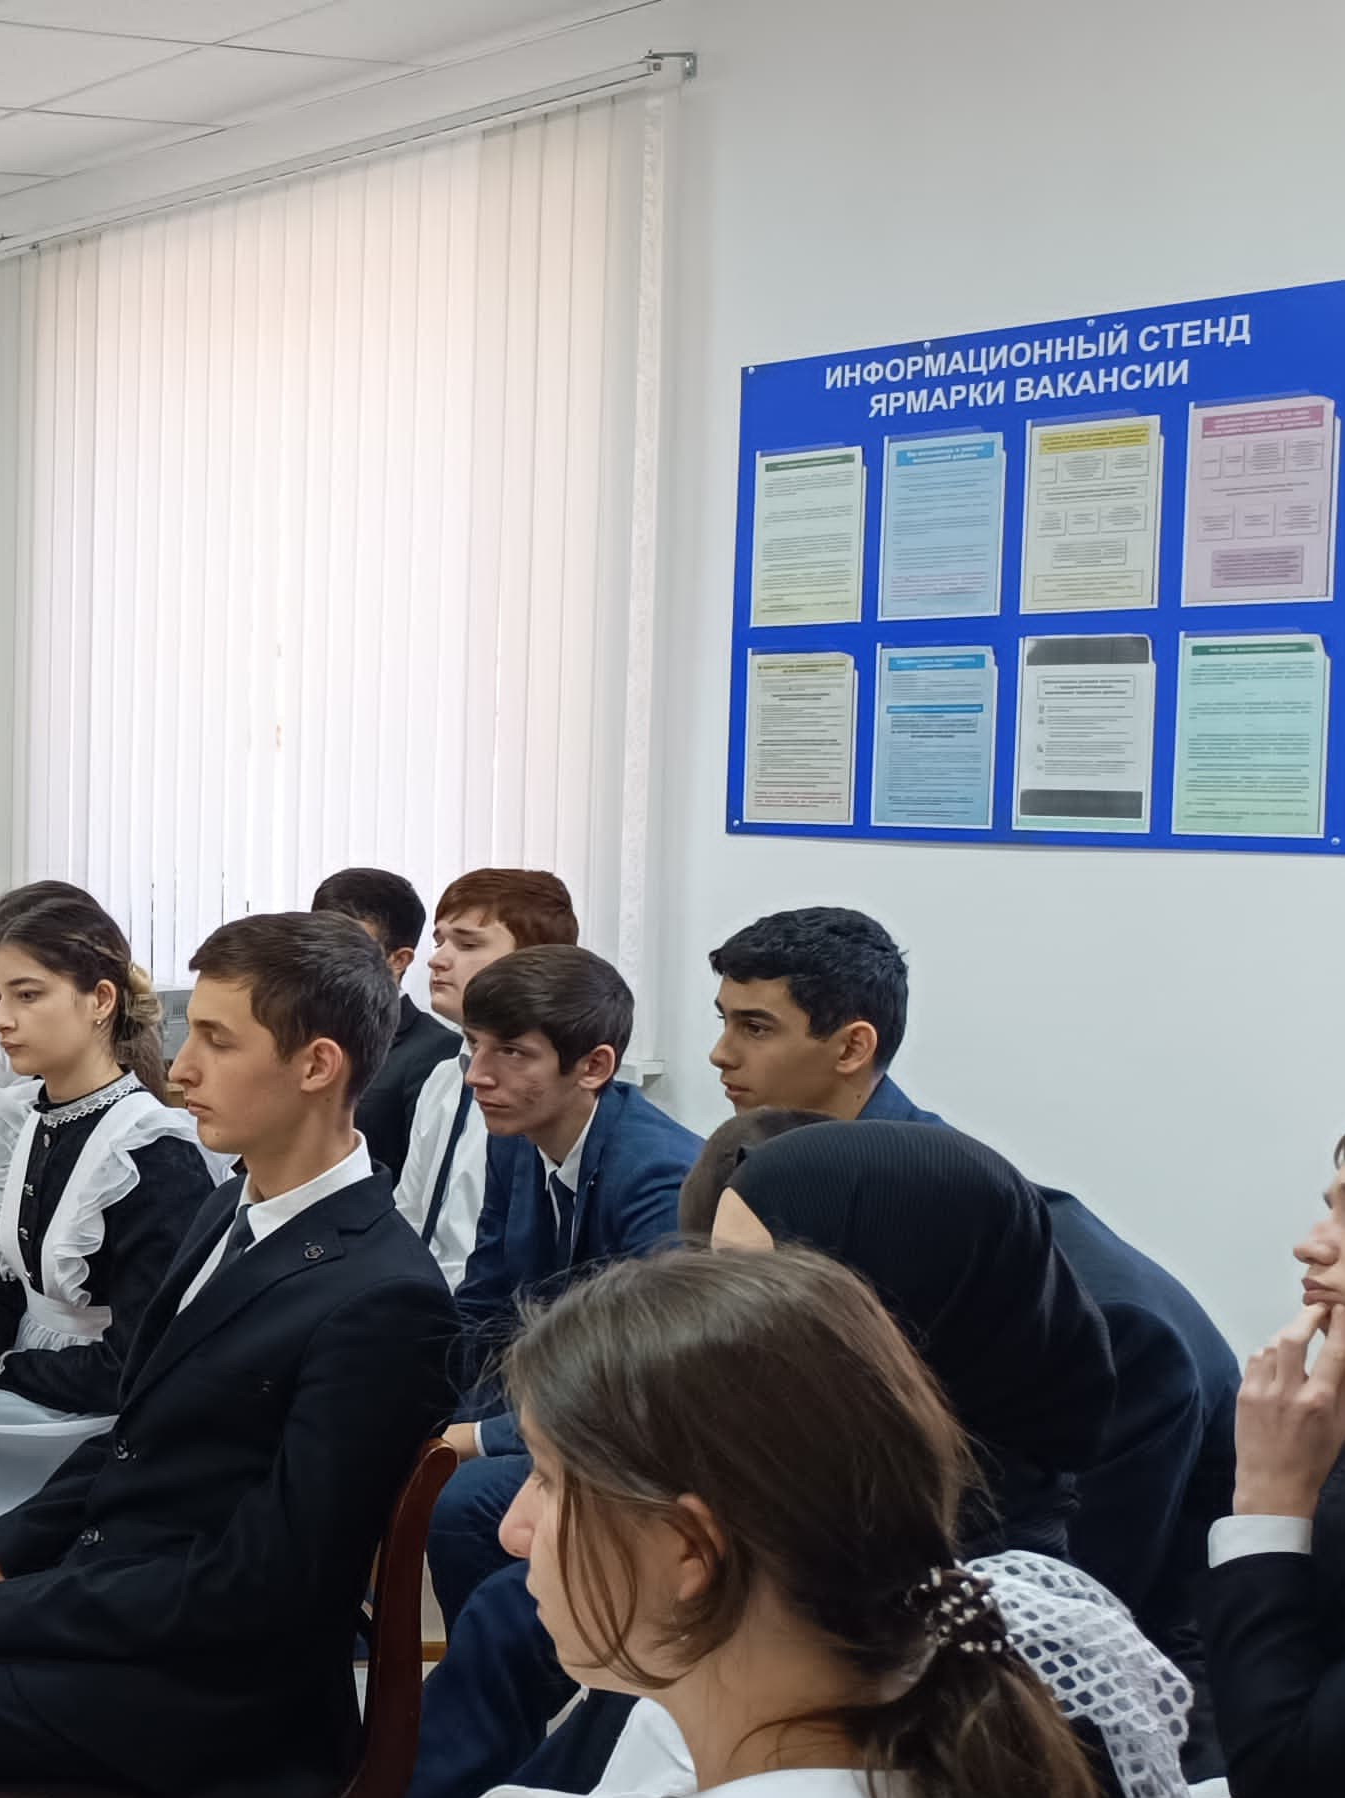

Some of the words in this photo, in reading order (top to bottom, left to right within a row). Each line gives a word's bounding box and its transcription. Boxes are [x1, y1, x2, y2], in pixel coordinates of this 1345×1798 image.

[825, 322, 1128, 390] ИНФОРМАЦИОННЫЙ
[1138, 314, 1251, 352] СТЕНД
[869, 379, 1005, 419] ЯРМАРКИ
[1015, 359, 1189, 403] ВАКАНСИИ
